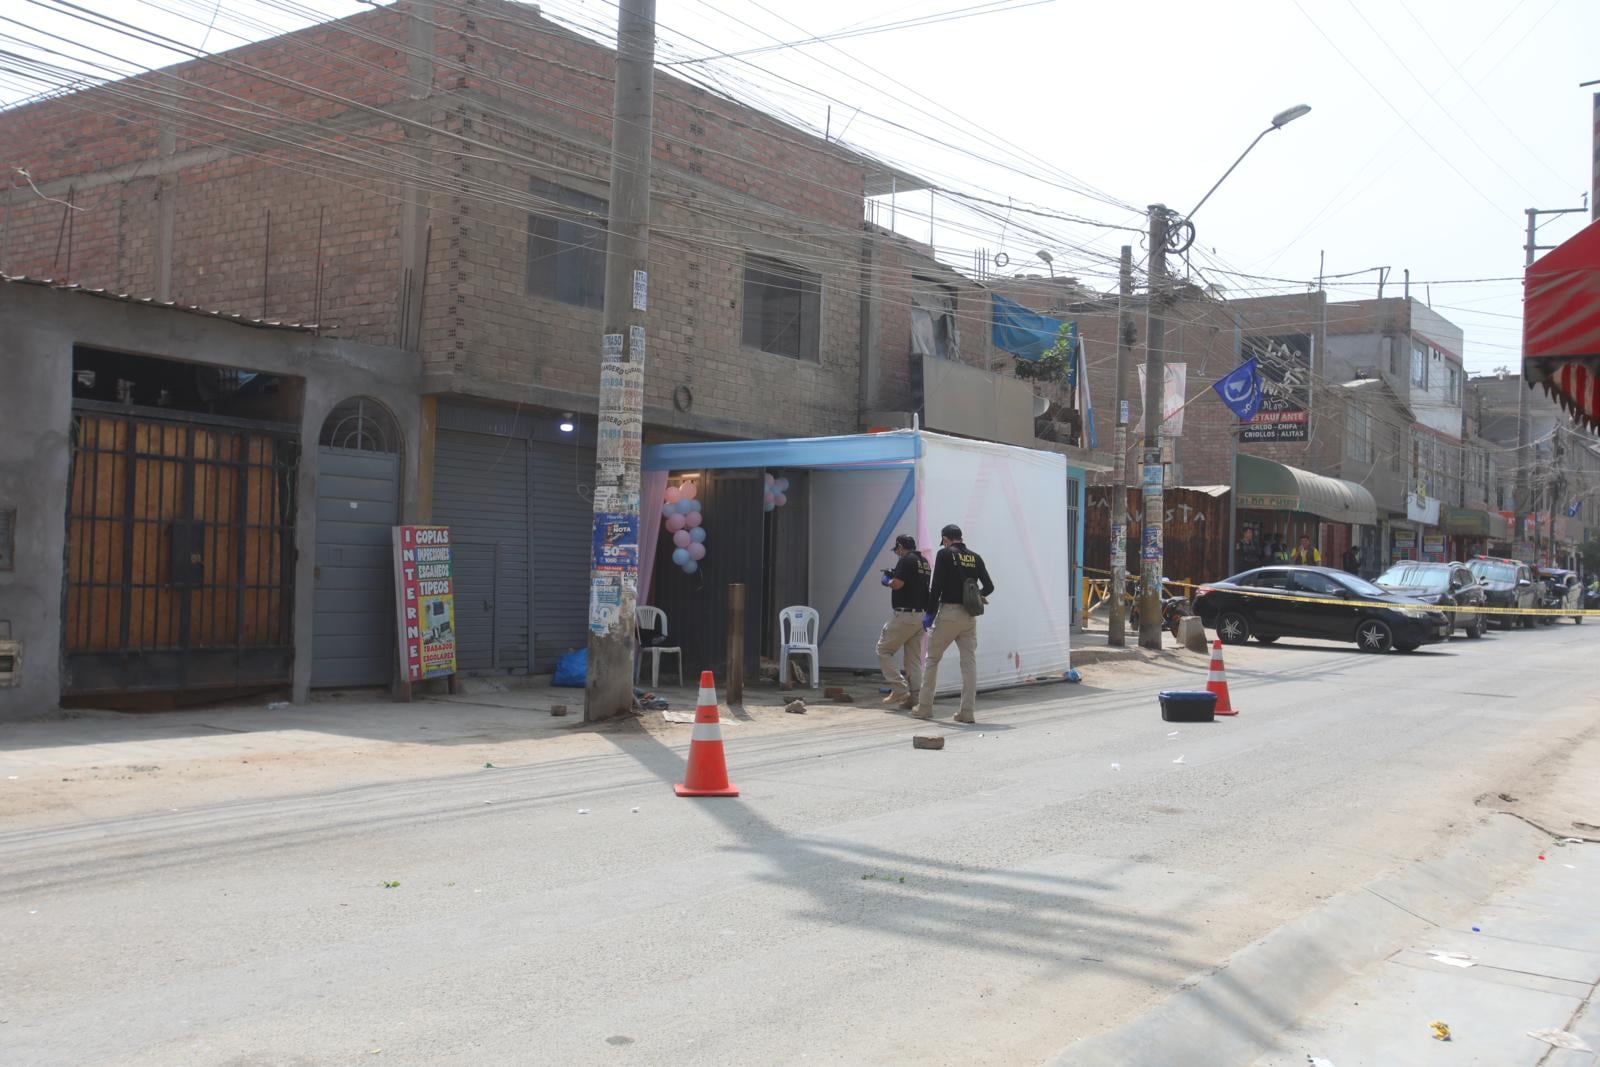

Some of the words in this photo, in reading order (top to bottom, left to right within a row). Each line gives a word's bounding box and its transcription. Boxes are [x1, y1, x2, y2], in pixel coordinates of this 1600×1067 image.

[1087, 495, 1110, 508] LA
[416, 530, 449, 544] COPIAS
[603, 546, 620, 557] 50
[418, 564, 450, 579] ESCANEOS
[419, 580, 449, 596] TIPEOS
[402, 530, 420, 677] INTERNET
